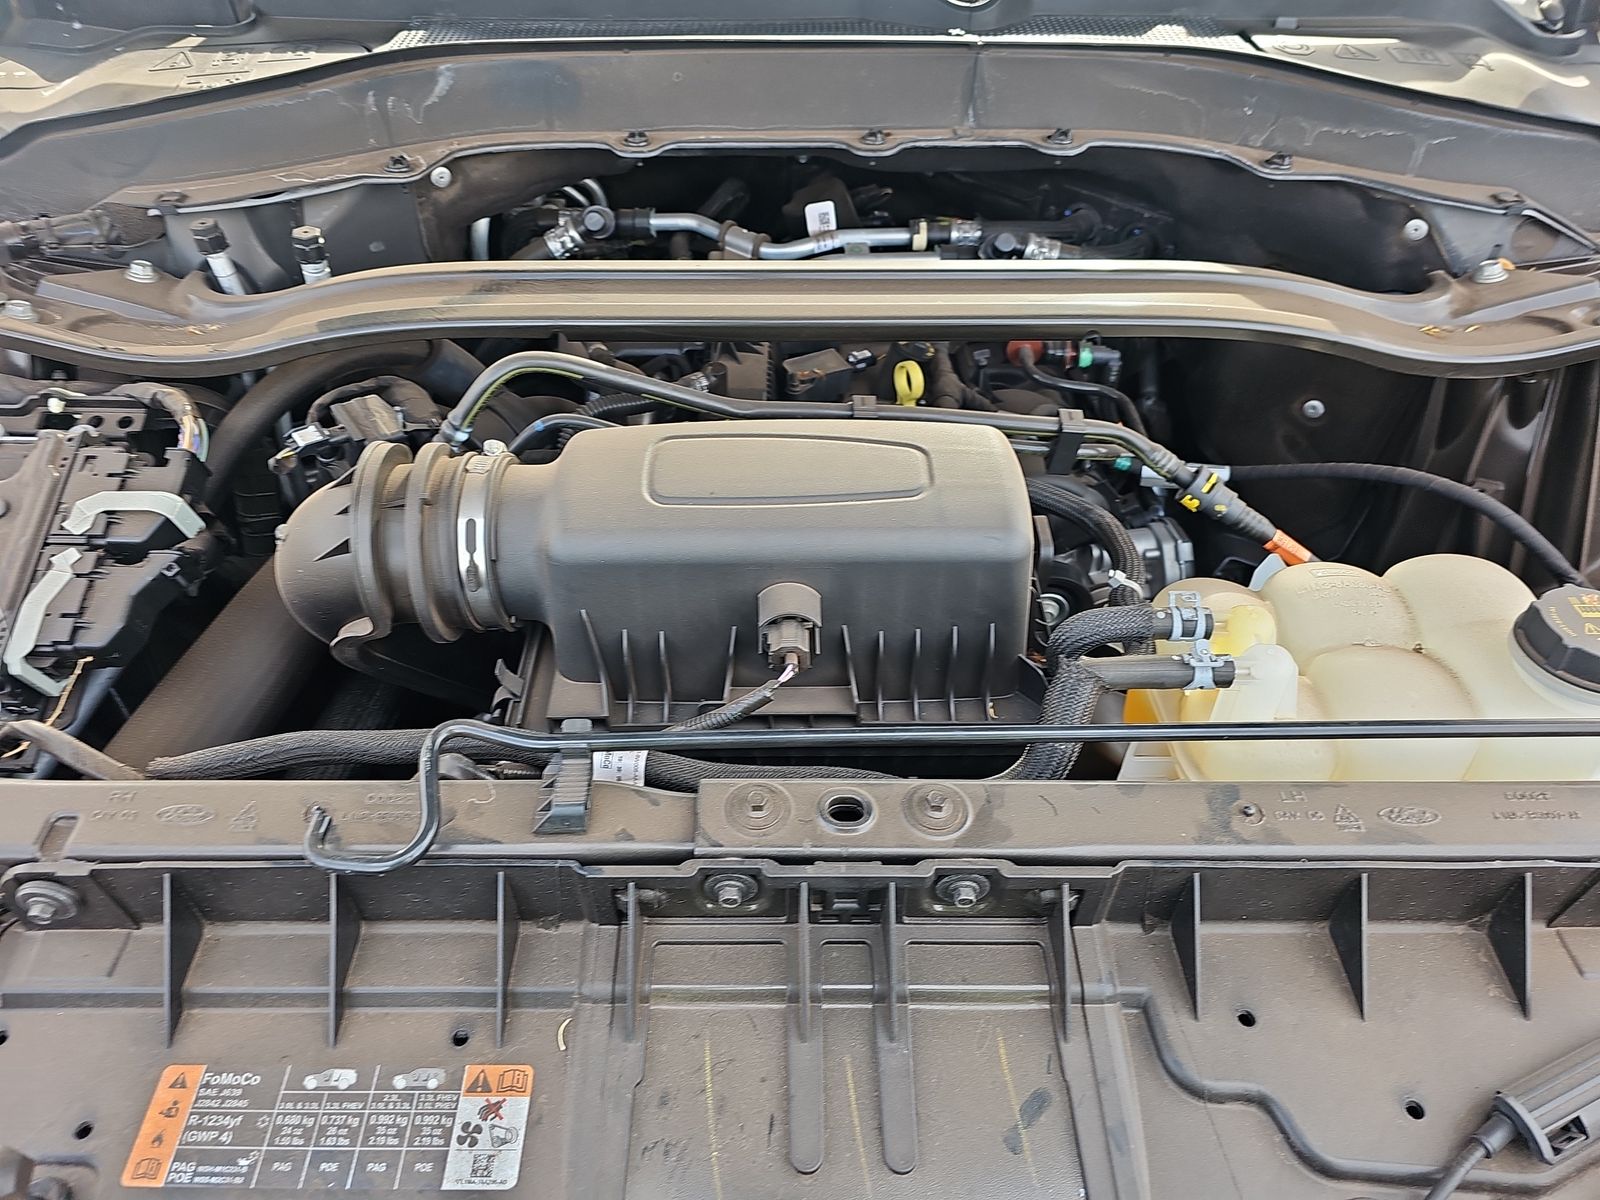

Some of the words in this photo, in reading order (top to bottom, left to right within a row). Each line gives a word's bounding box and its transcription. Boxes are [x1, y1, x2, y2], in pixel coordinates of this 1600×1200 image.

[202, 1072, 261, 1085] FoMoCo
[198, 1088, 219, 1097] SAE
[219, 1088, 244, 1097] J639
[187, 1115, 244, 1130] R-1234yf
[301, 1113, 316, 1128] kg
[320, 1114, 347, 1125] 0.737
[345, 1113, 360, 1128] kg
[369, 1114, 396, 1125] 0.992
[395, 1113, 409, 1127] kg
[414, 1114, 440, 1125] 0.992
[440, 1113, 454, 1127] kg
[279, 1127, 292, 1135] 24
[182, 1131, 218, 1144] (GWP
[218, 1131, 233, 1145] 4)
[291, 1136, 305, 1145] lbs
[336, 1136, 350, 1145] lbs
[367, 1136, 386, 1145] 2.19
[386, 1136, 400, 1145] lbs
[412, 1136, 431, 1145] 2.19
[431, 1136, 445, 1145] lbs
[170, 1162, 197, 1172] PAG
[271, 1162, 293, 1172] PAG
[318, 1162, 341, 1172] POE
[366, 1162, 387, 1172] PAG
[414, 1162, 436, 1172] POE
[166, 1173, 194, 1183] POE
